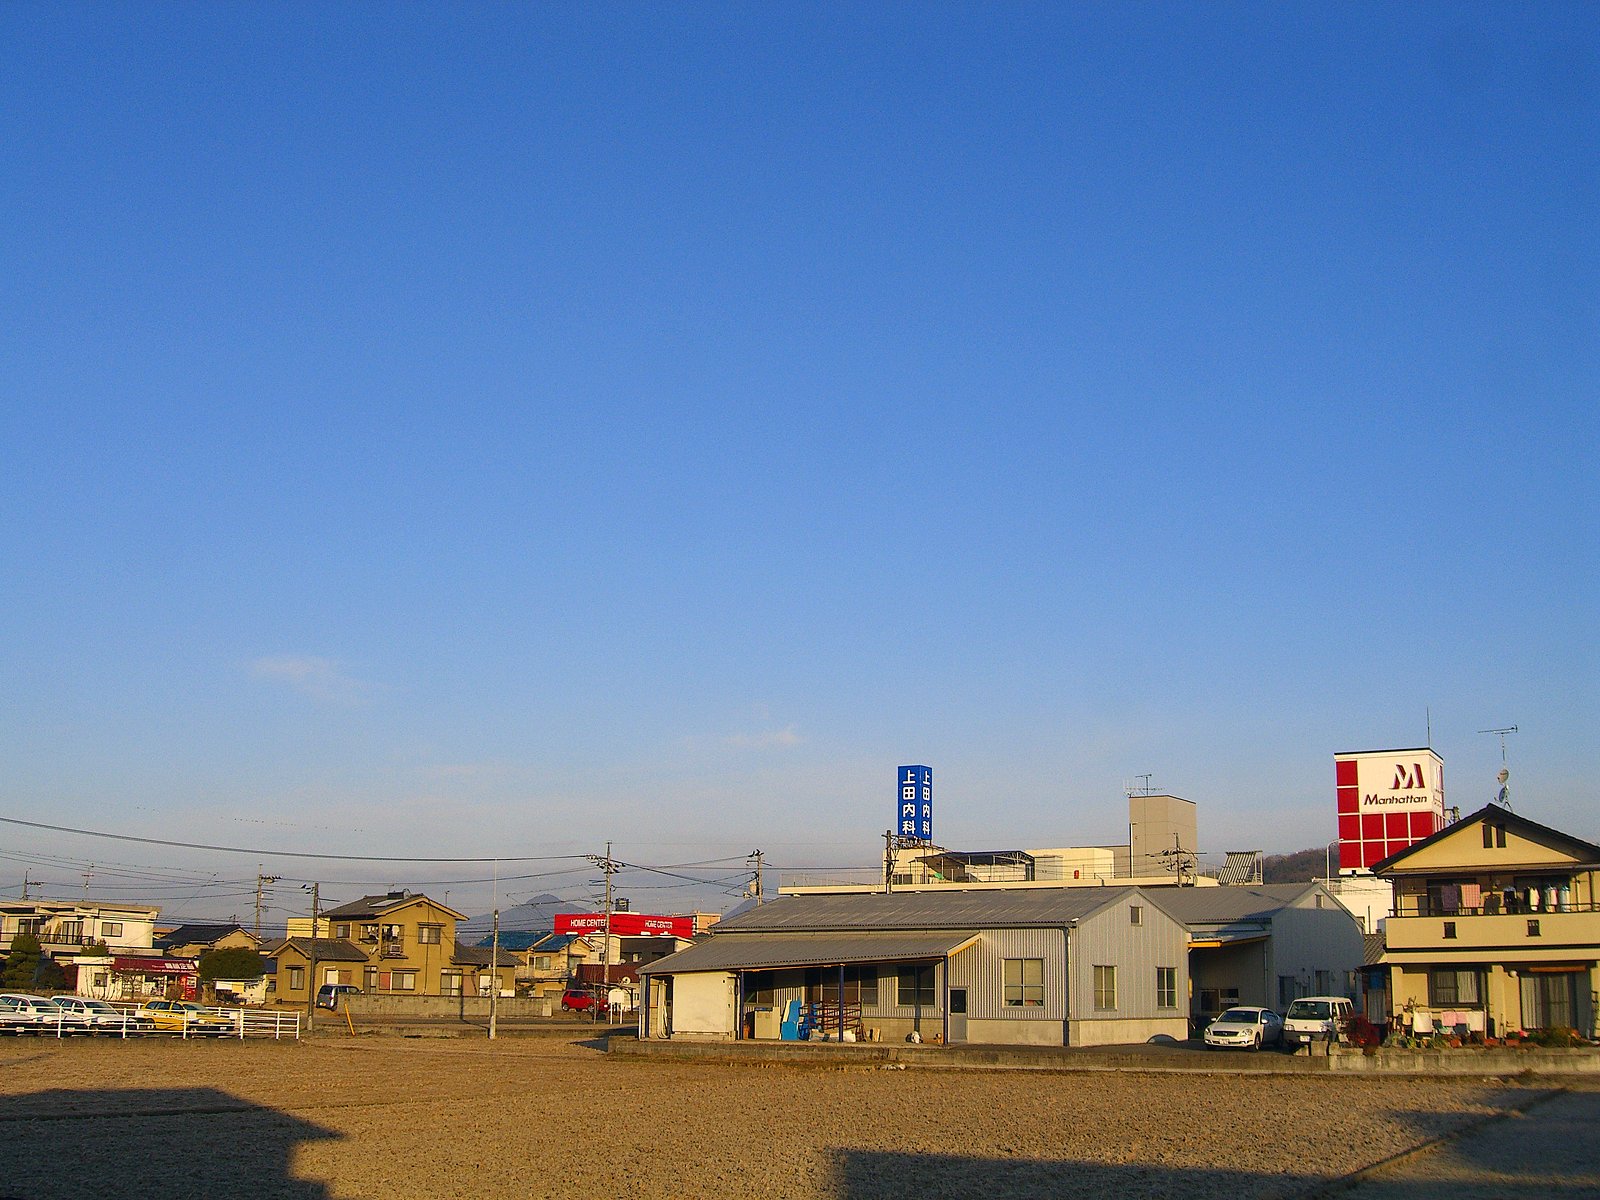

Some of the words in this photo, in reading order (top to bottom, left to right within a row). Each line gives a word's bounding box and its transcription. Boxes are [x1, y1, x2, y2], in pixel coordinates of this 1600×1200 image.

[902, 769, 916, 835] 上田内科
[922, 770, 931, 836] 上田内科
[1363, 793, 1428, 806] Manhattan
[570, 919, 586, 927] HOME
[644, 919, 657, 928] HOME
